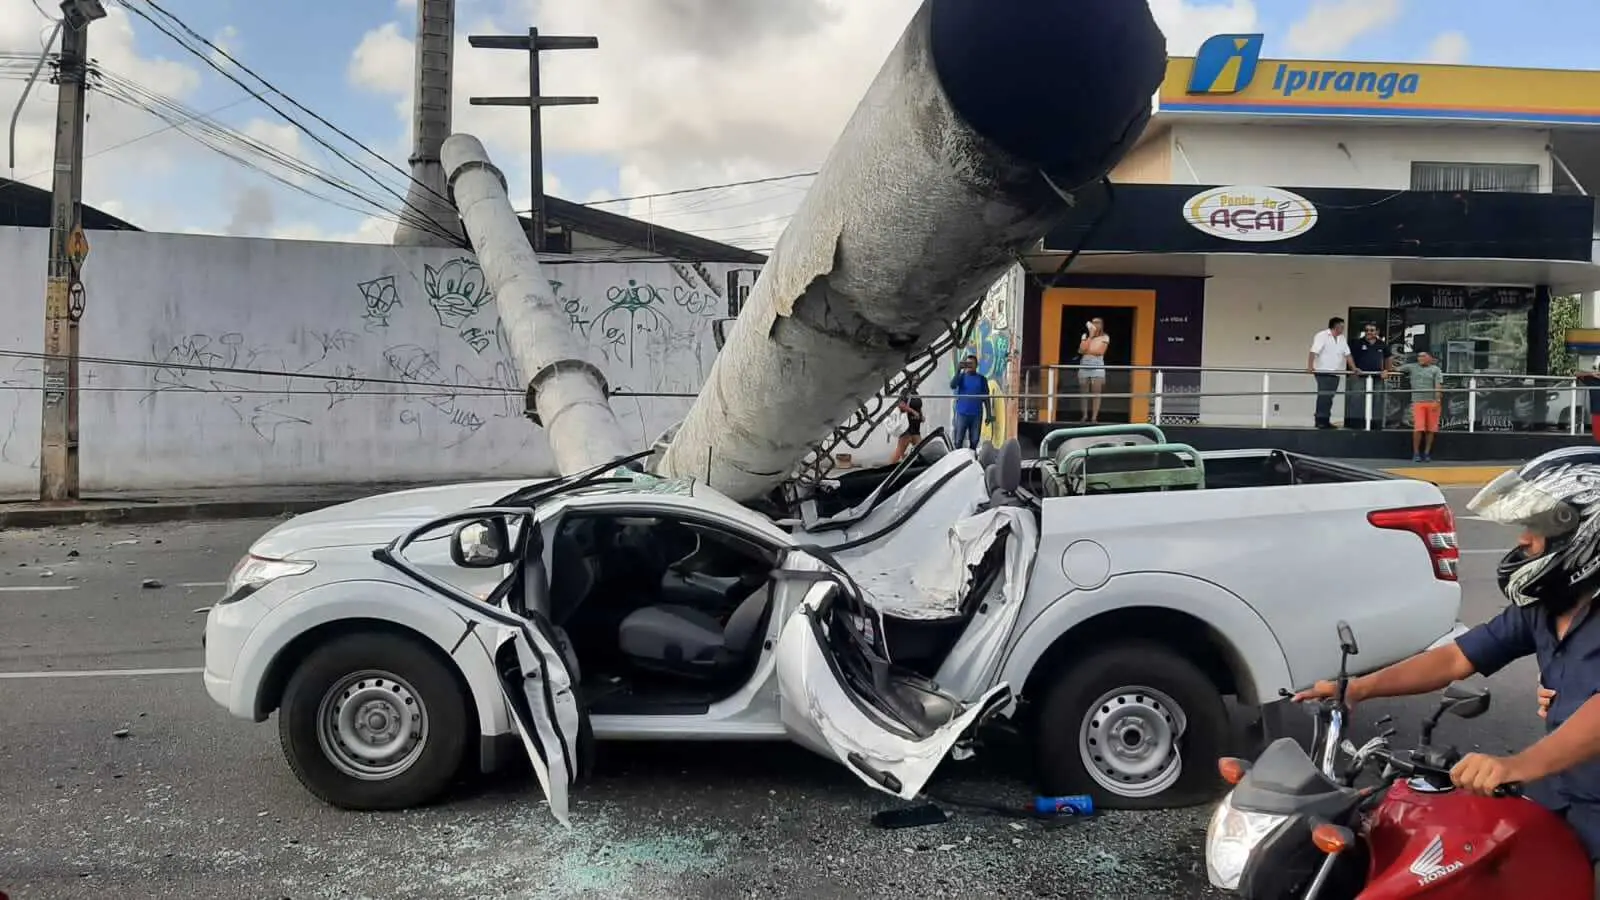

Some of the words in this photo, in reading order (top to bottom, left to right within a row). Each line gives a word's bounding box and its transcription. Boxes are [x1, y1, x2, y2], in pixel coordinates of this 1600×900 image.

[1272, 63, 1420, 99] Ipiranga
[1210, 200, 1290, 233] AÇAÍ
[1417, 860, 1465, 887] HONDA
